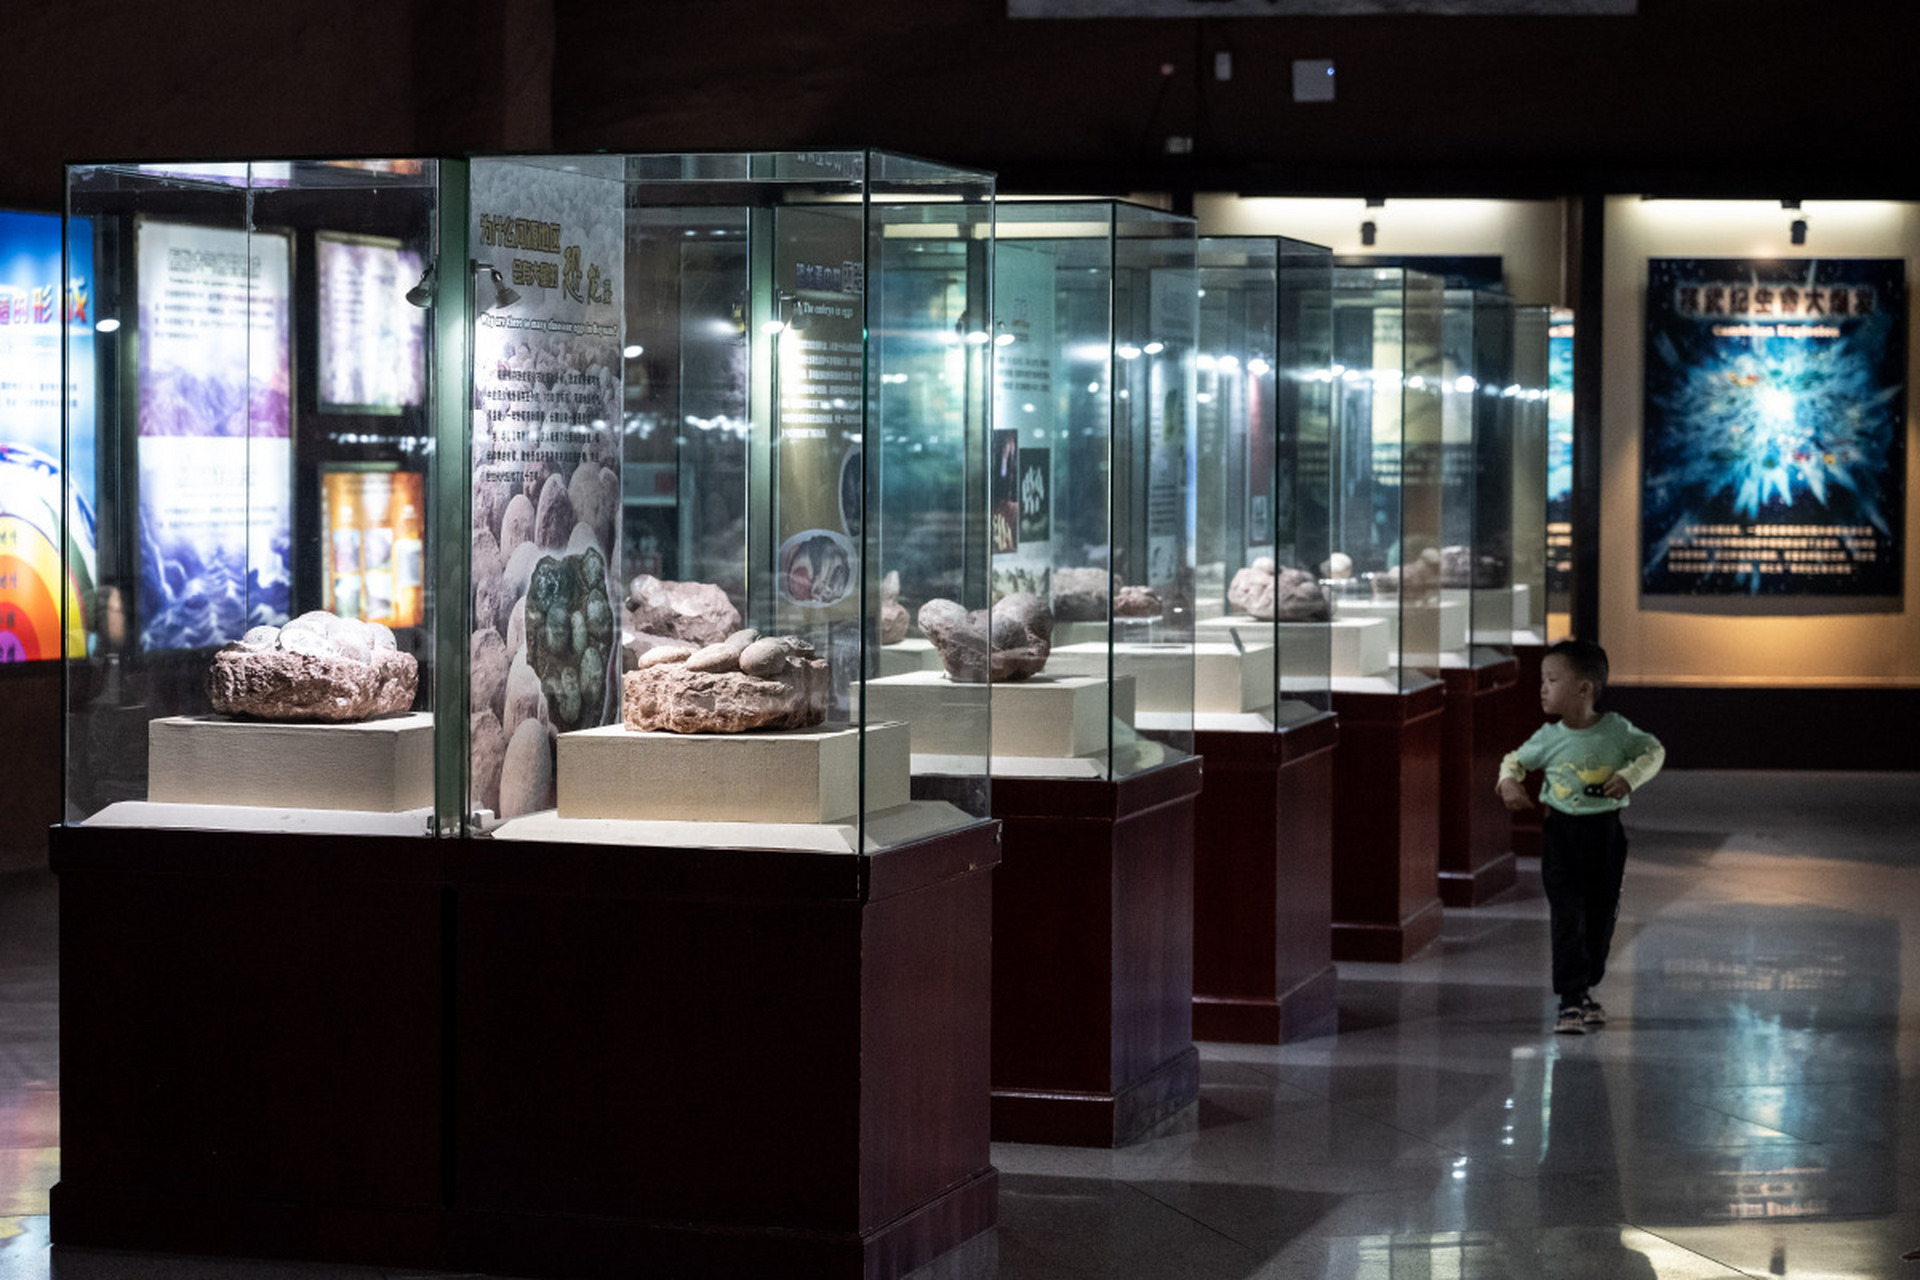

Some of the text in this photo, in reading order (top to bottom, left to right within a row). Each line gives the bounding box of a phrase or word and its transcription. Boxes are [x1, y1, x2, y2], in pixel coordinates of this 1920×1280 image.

[480, 213, 561, 254] 为什么河源地区
